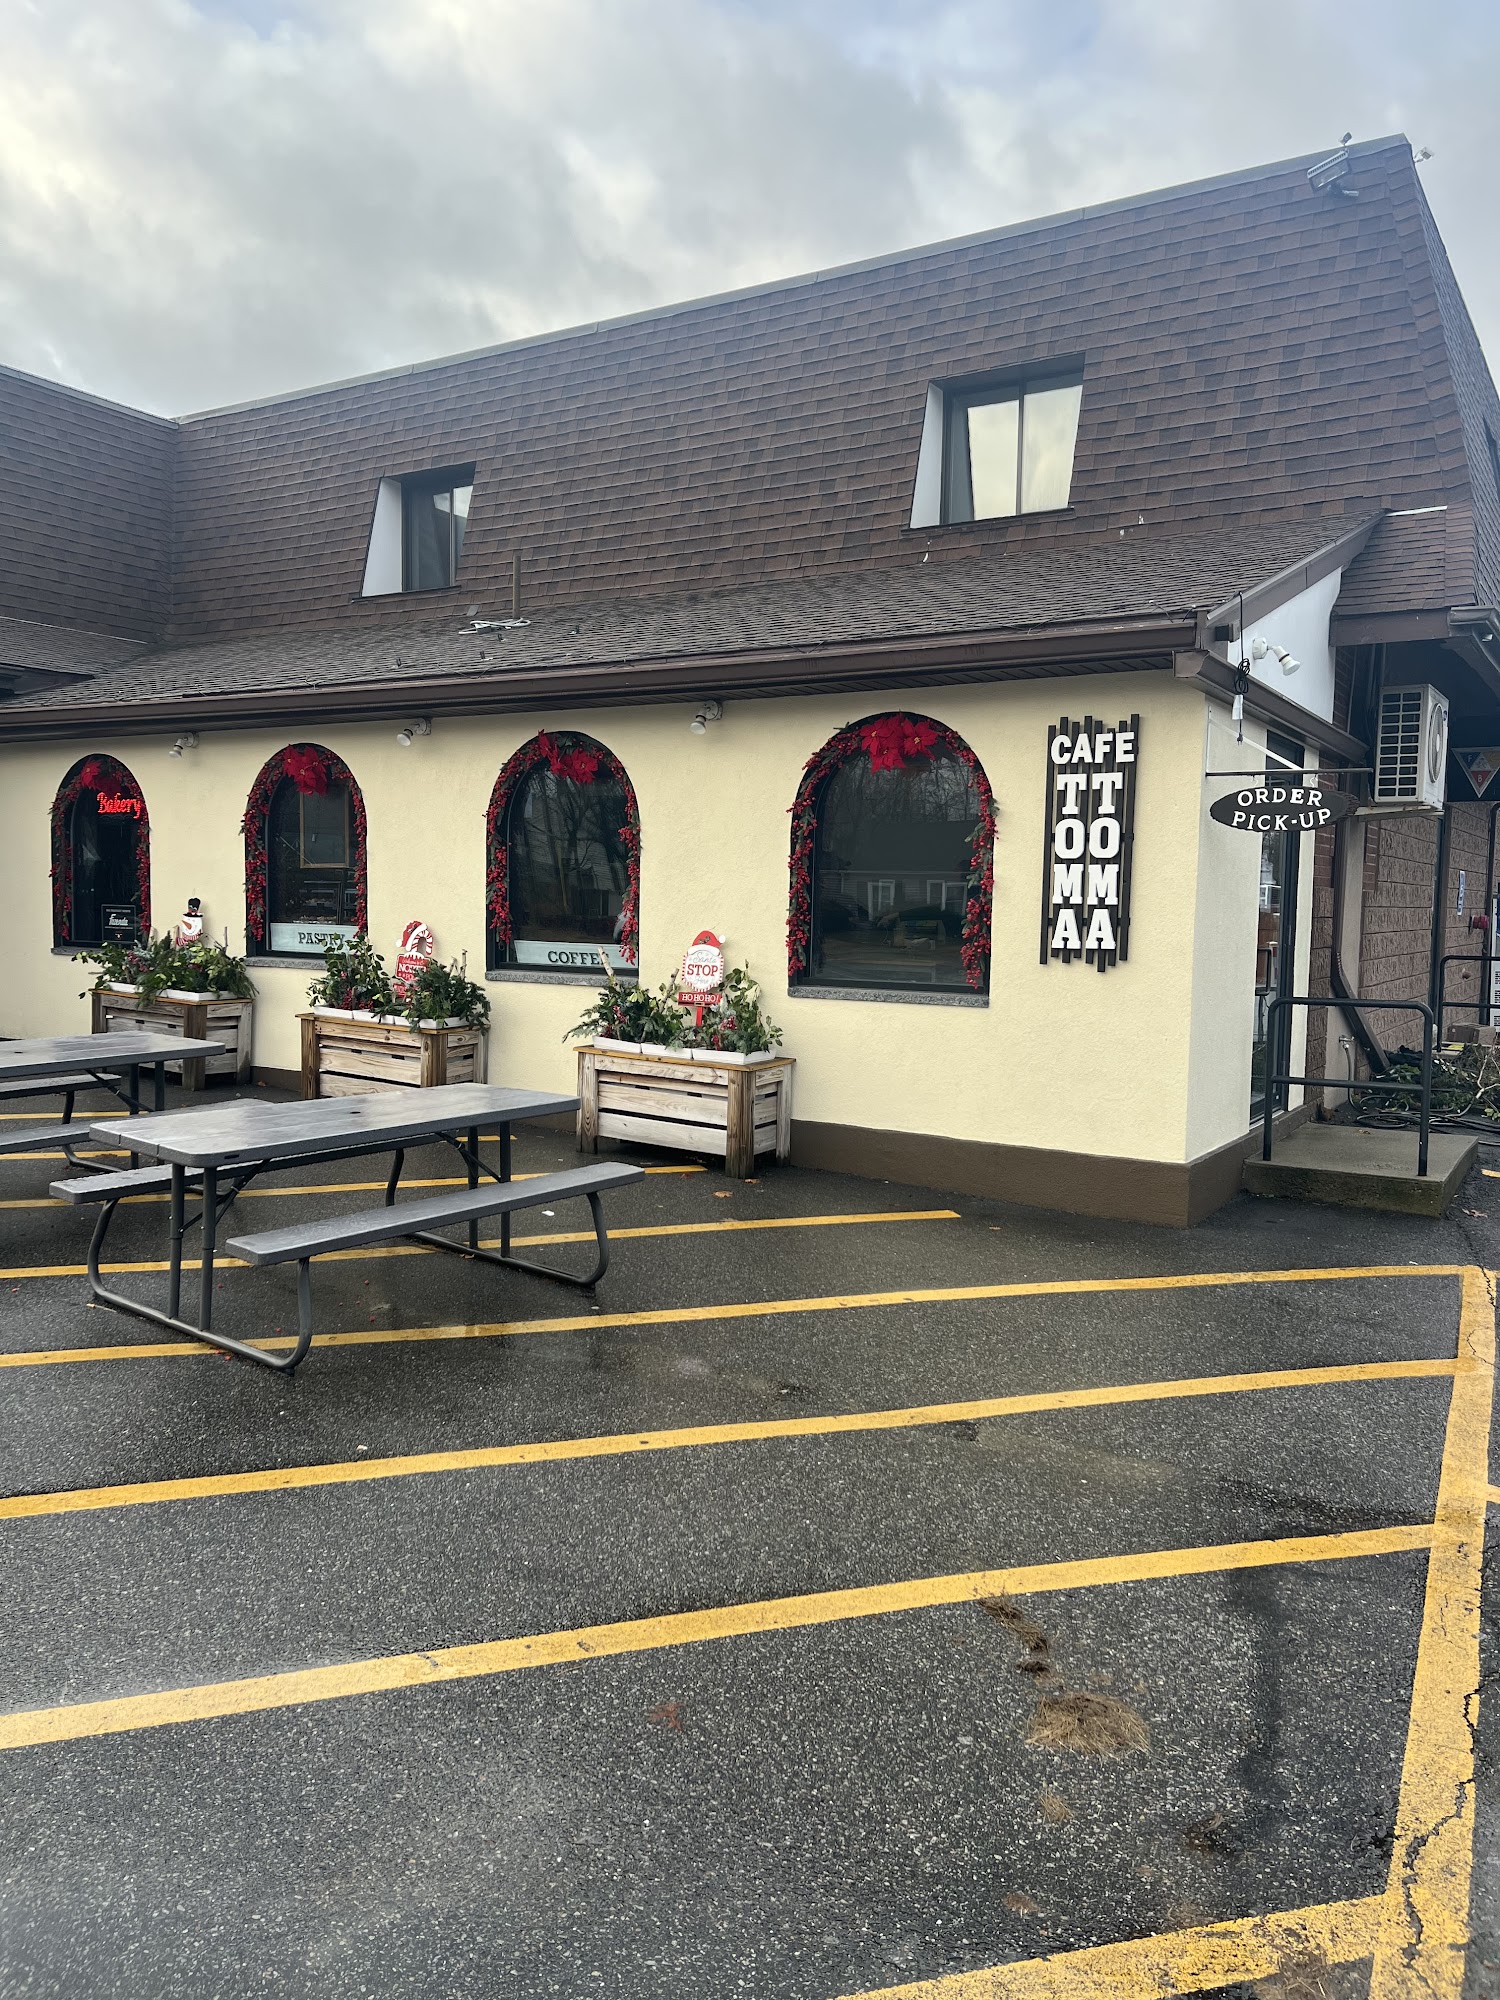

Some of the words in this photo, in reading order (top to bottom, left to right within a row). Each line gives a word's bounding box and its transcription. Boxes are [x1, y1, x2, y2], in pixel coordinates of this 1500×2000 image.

[1051, 732, 1135, 765] CAFE
[96, 792, 141, 819] Bakery
[1237, 787, 1323, 807] ORDER
[1231, 808, 1331, 831] PICK-UP
[547, 950, 609, 965] COFFE
[687, 963, 719, 977] STOP
[682, 993, 693, 1001] HO
[693, 993, 705, 1002] HO
